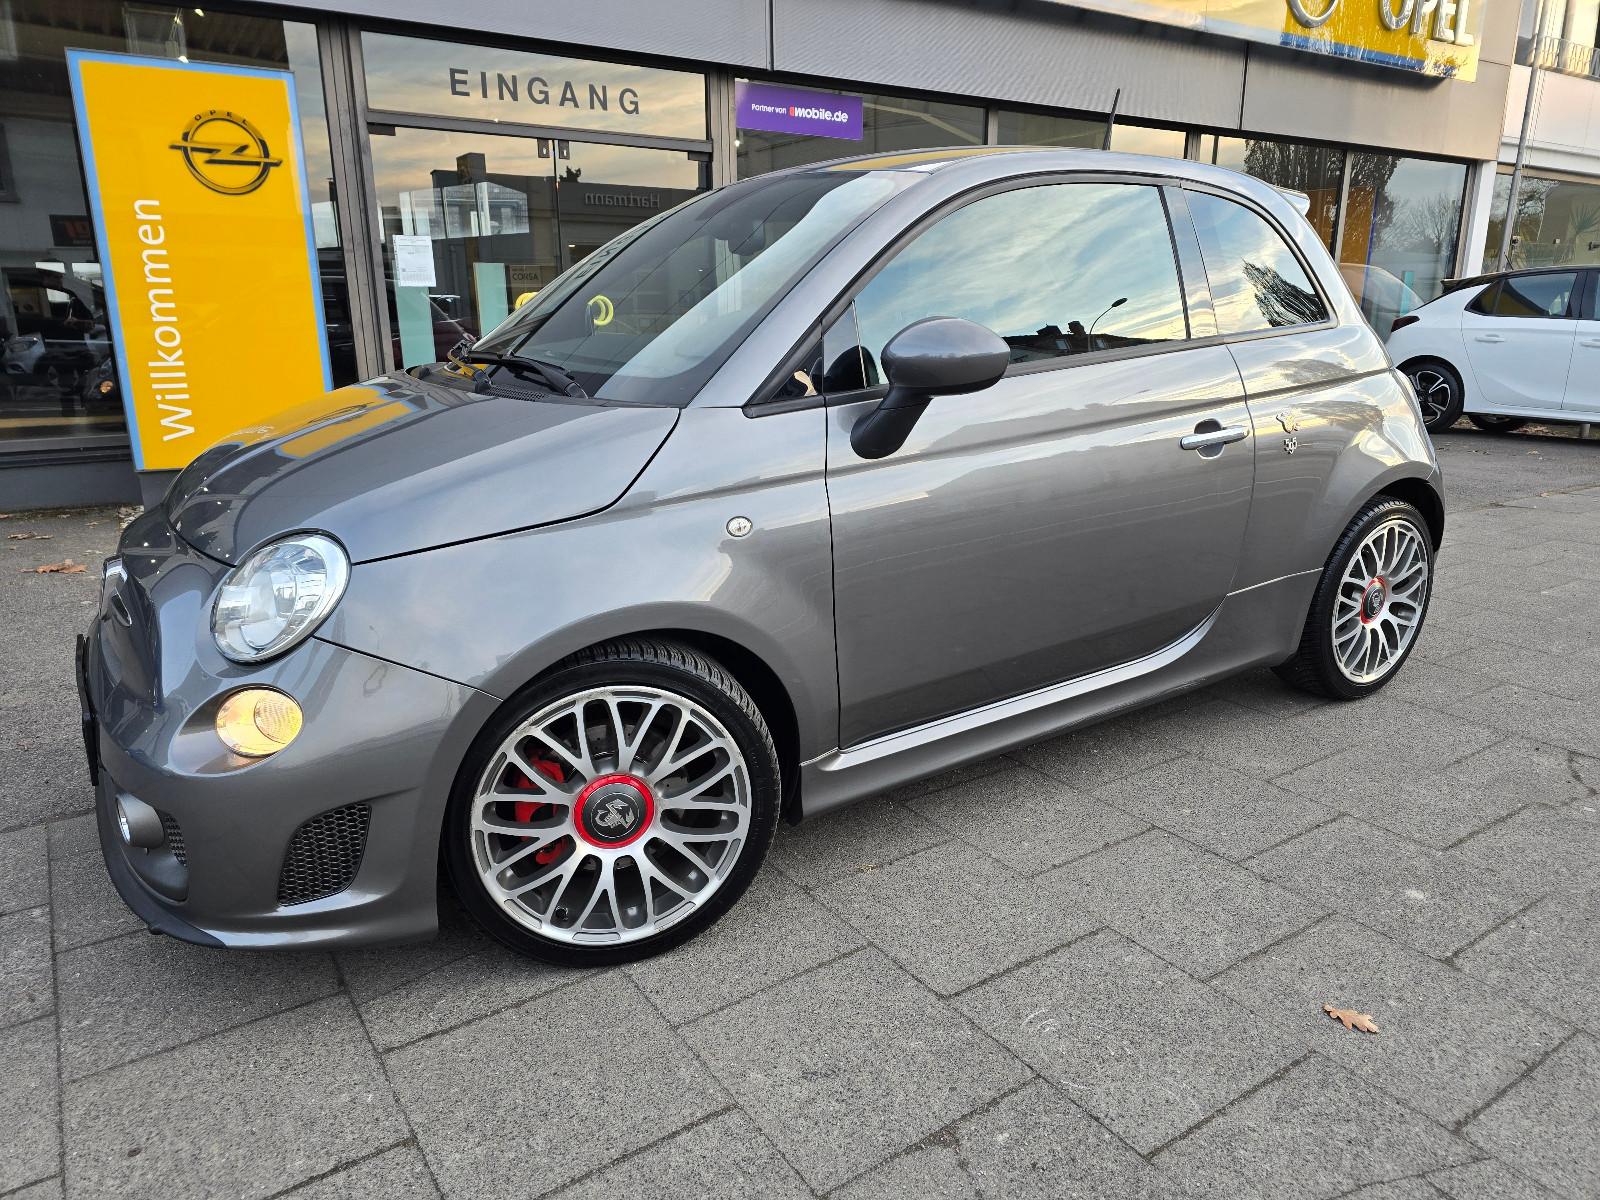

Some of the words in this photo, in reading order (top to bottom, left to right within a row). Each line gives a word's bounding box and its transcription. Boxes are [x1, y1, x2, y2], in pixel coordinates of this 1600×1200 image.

[449, 67, 640, 115] EINGANG
[194, 109, 248, 126] OPEL
[751, 103, 775, 114] Partner
[775, 106, 787, 115] von
[794, 106, 849, 123] mobile.de
[134, 199, 195, 442] Willkommen
